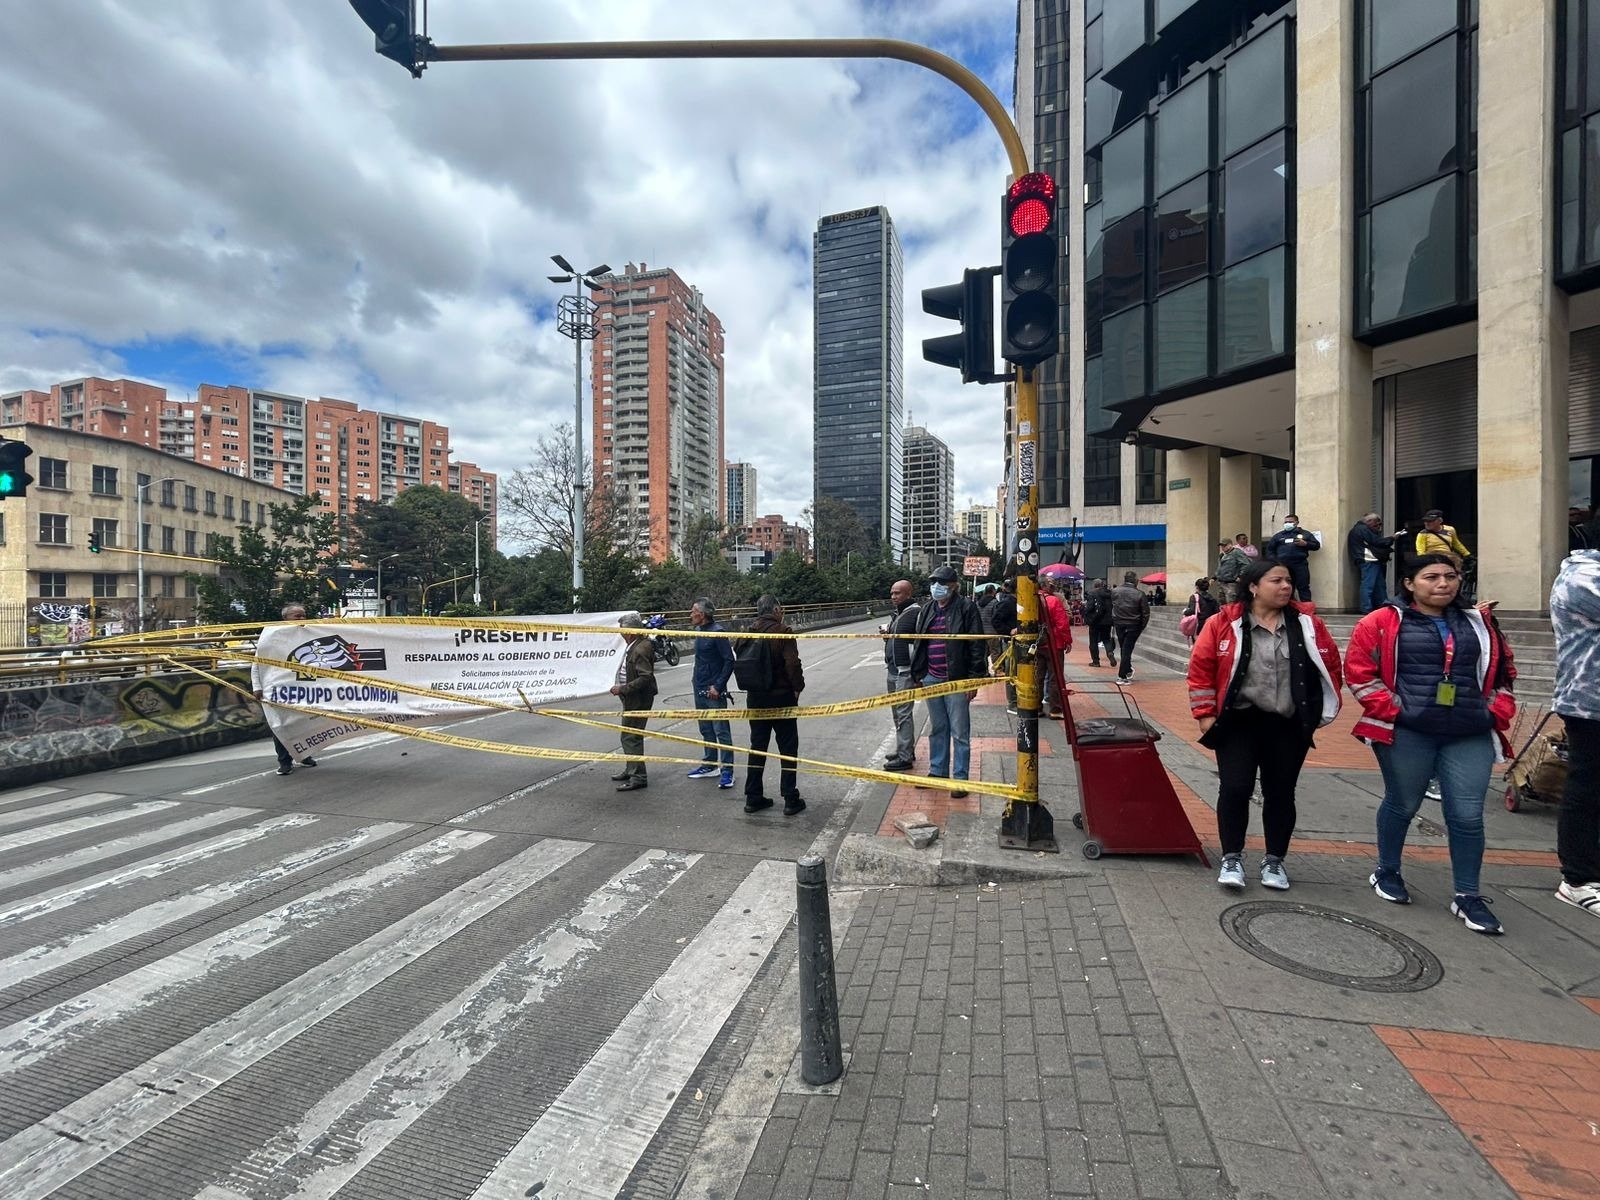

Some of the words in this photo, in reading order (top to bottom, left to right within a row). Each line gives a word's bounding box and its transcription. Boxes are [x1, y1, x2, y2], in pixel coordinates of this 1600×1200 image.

[454, 628, 569, 647] ¡PRESENTE!
[405, 653, 479, 662] RESPALDAMOS
[482, 653, 495, 661] AL
[498, 651, 551, 661] GOBIERNO
[553, 650, 572, 660] DEL
[575, 649, 616, 659] CAMBIO
[461, 669, 500, 678] Solicitamos
[501, 668, 538, 677] instalación
[538, 668, 548, 676] de
[430, 682, 455, 691] MESA
[456, 679, 511, 691] EVALUACIÓN
[512, 680, 525, 689] DE
[526, 679, 544, 688] LOS
[271, 685, 332, 705] ASEPUPD
[337, 686, 398, 704] COLOMBIA
[293, 742, 307, 754] EL
[306, 725, 345, 747] RESPETO
[344, 727, 351, 736] A
